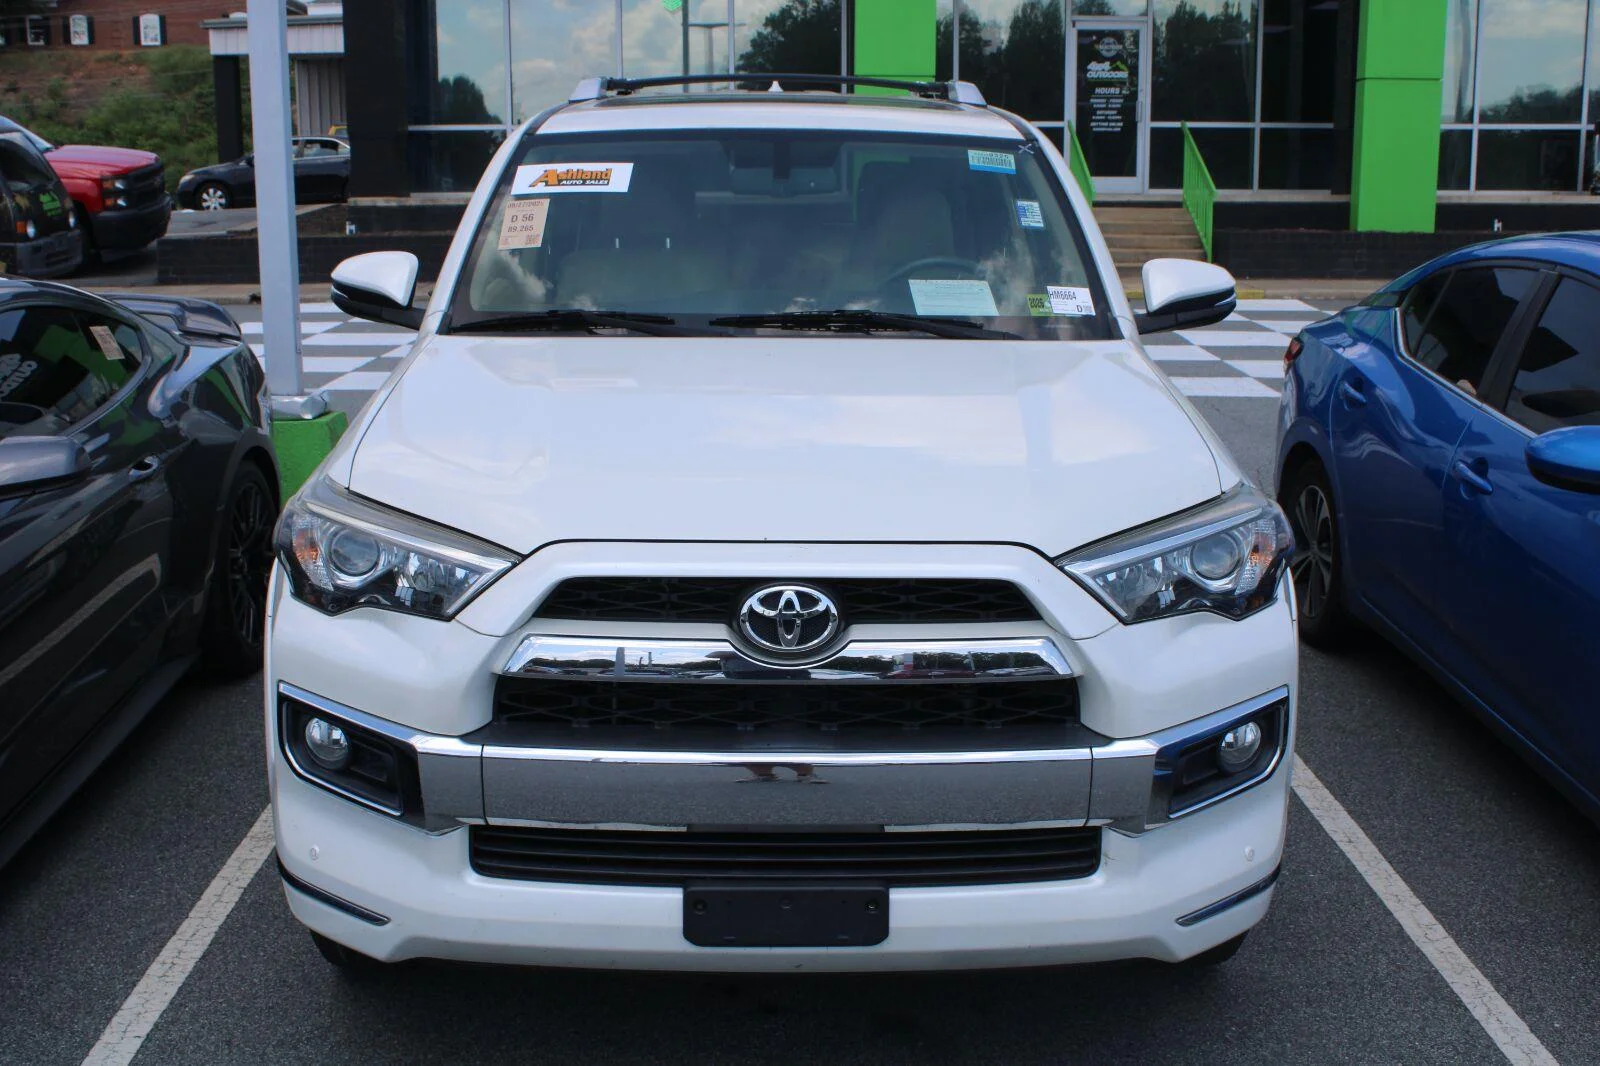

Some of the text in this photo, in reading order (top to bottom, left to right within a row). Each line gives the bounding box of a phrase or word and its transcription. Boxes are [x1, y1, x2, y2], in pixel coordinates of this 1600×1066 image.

[529, 168, 612, 188] Ashland
[511, 213, 535, 223] D 56
